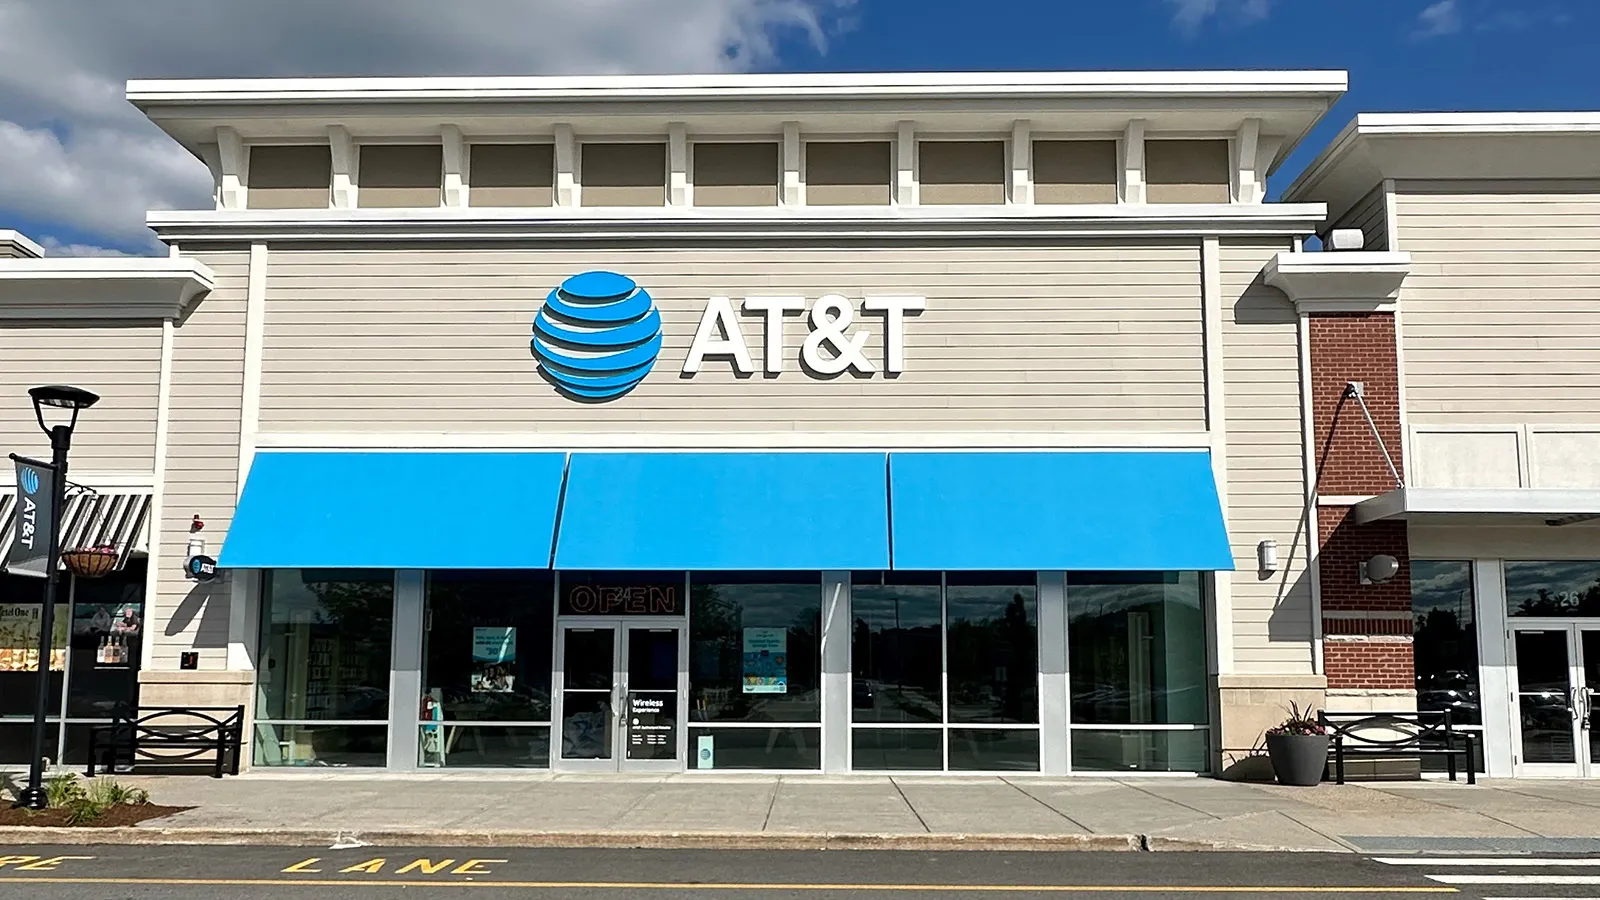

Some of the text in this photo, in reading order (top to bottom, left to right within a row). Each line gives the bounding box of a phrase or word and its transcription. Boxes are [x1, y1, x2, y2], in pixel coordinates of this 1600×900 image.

[682, 294, 927, 377] AT&T
[21, 496, 37, 550] AT&T
[200, 563, 216, 574] AT&T
[569, 585, 676, 613] OPEN
[614, 586, 632, 602] 24
[1559, 591, 1579, 607] 26
[15, 607, 29, 617] One
[281, 857, 509, 874] LANE
